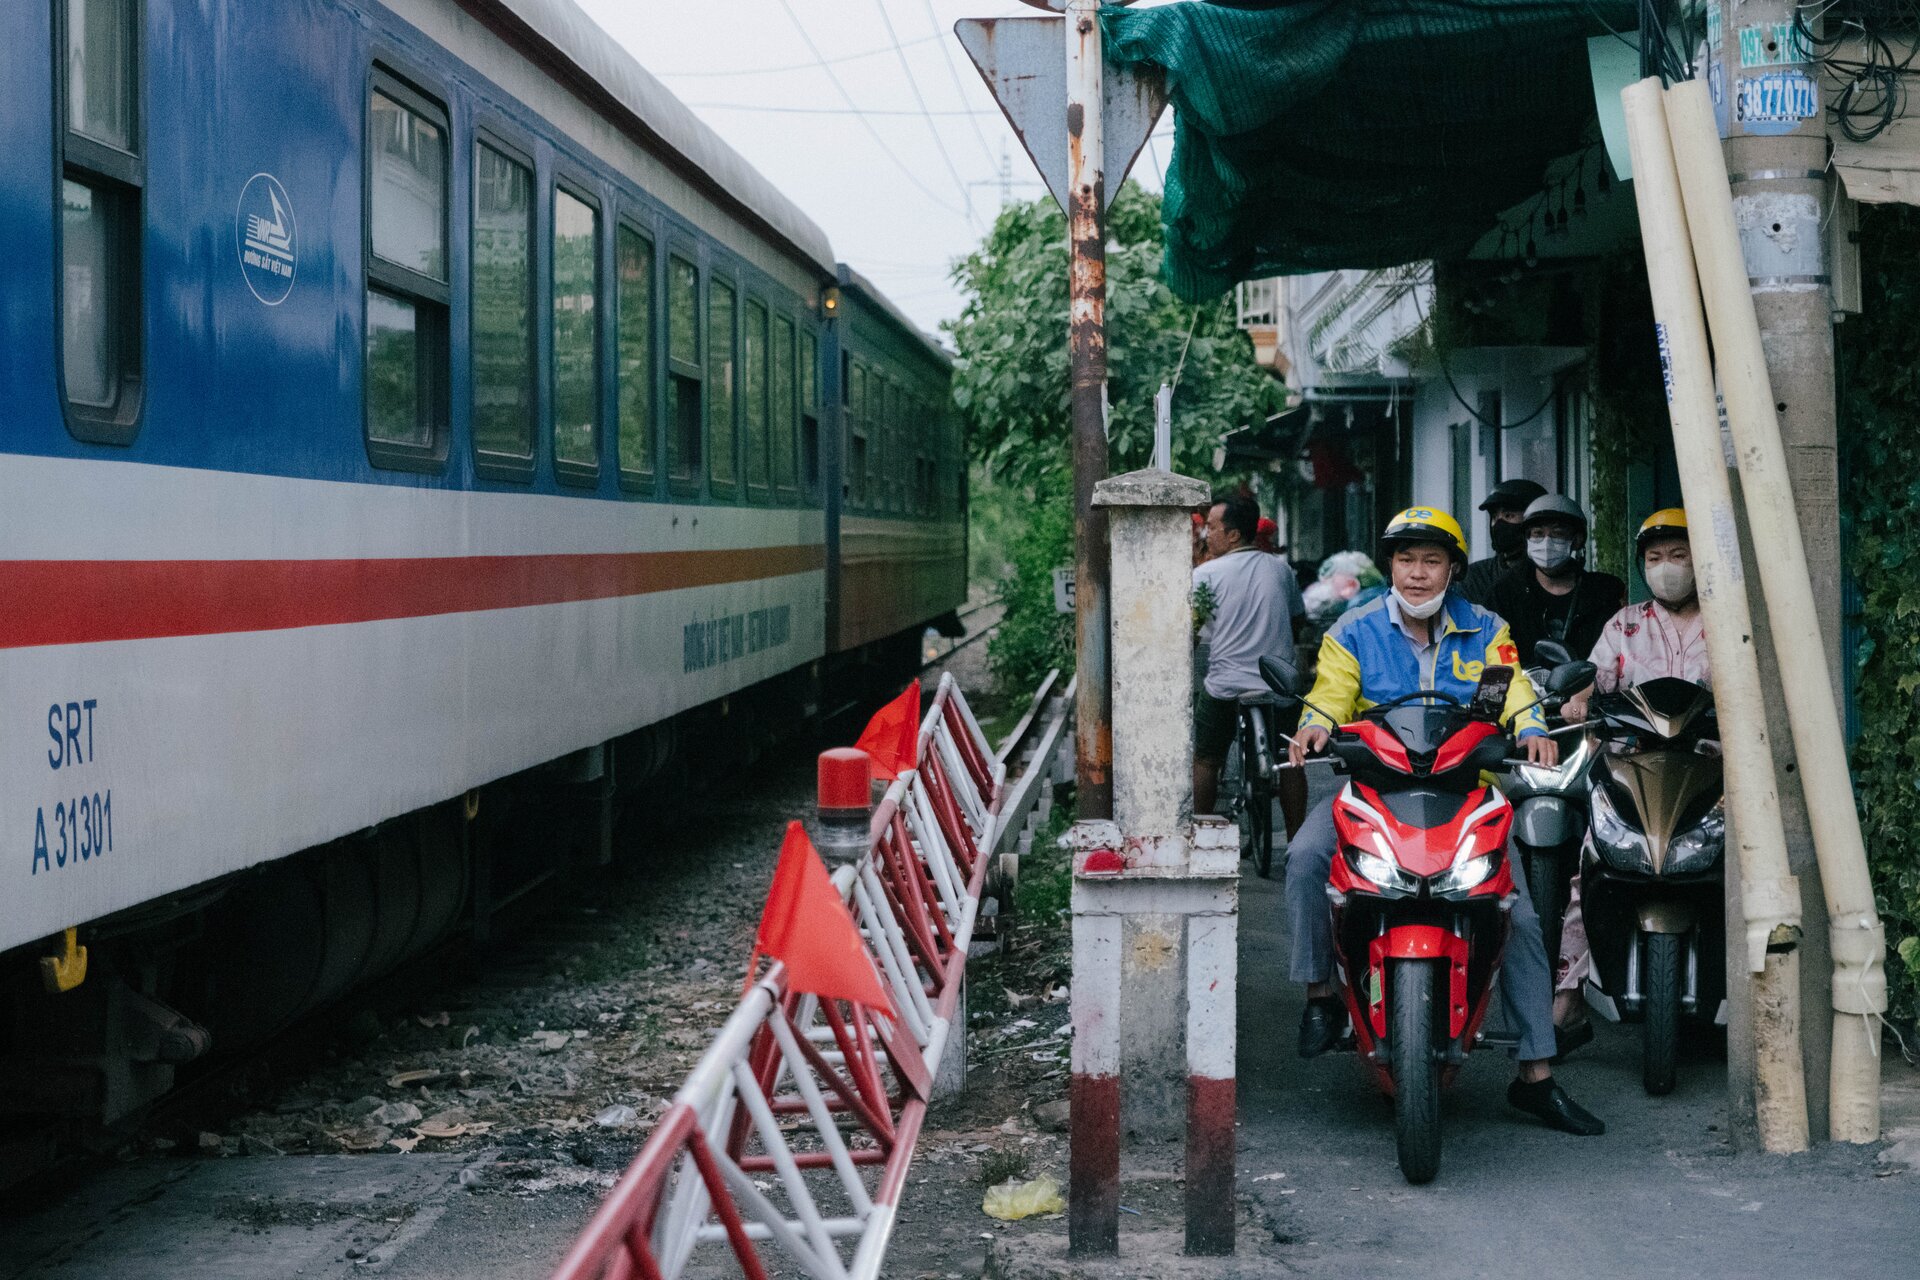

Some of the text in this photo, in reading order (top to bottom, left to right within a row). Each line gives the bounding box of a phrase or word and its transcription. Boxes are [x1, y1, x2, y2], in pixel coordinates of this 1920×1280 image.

[1405, 508, 1432, 519] be
[1452, 651, 1486, 682] be
[48, 699, 97, 770] SRT
[32, 789, 112, 875] A 31301
